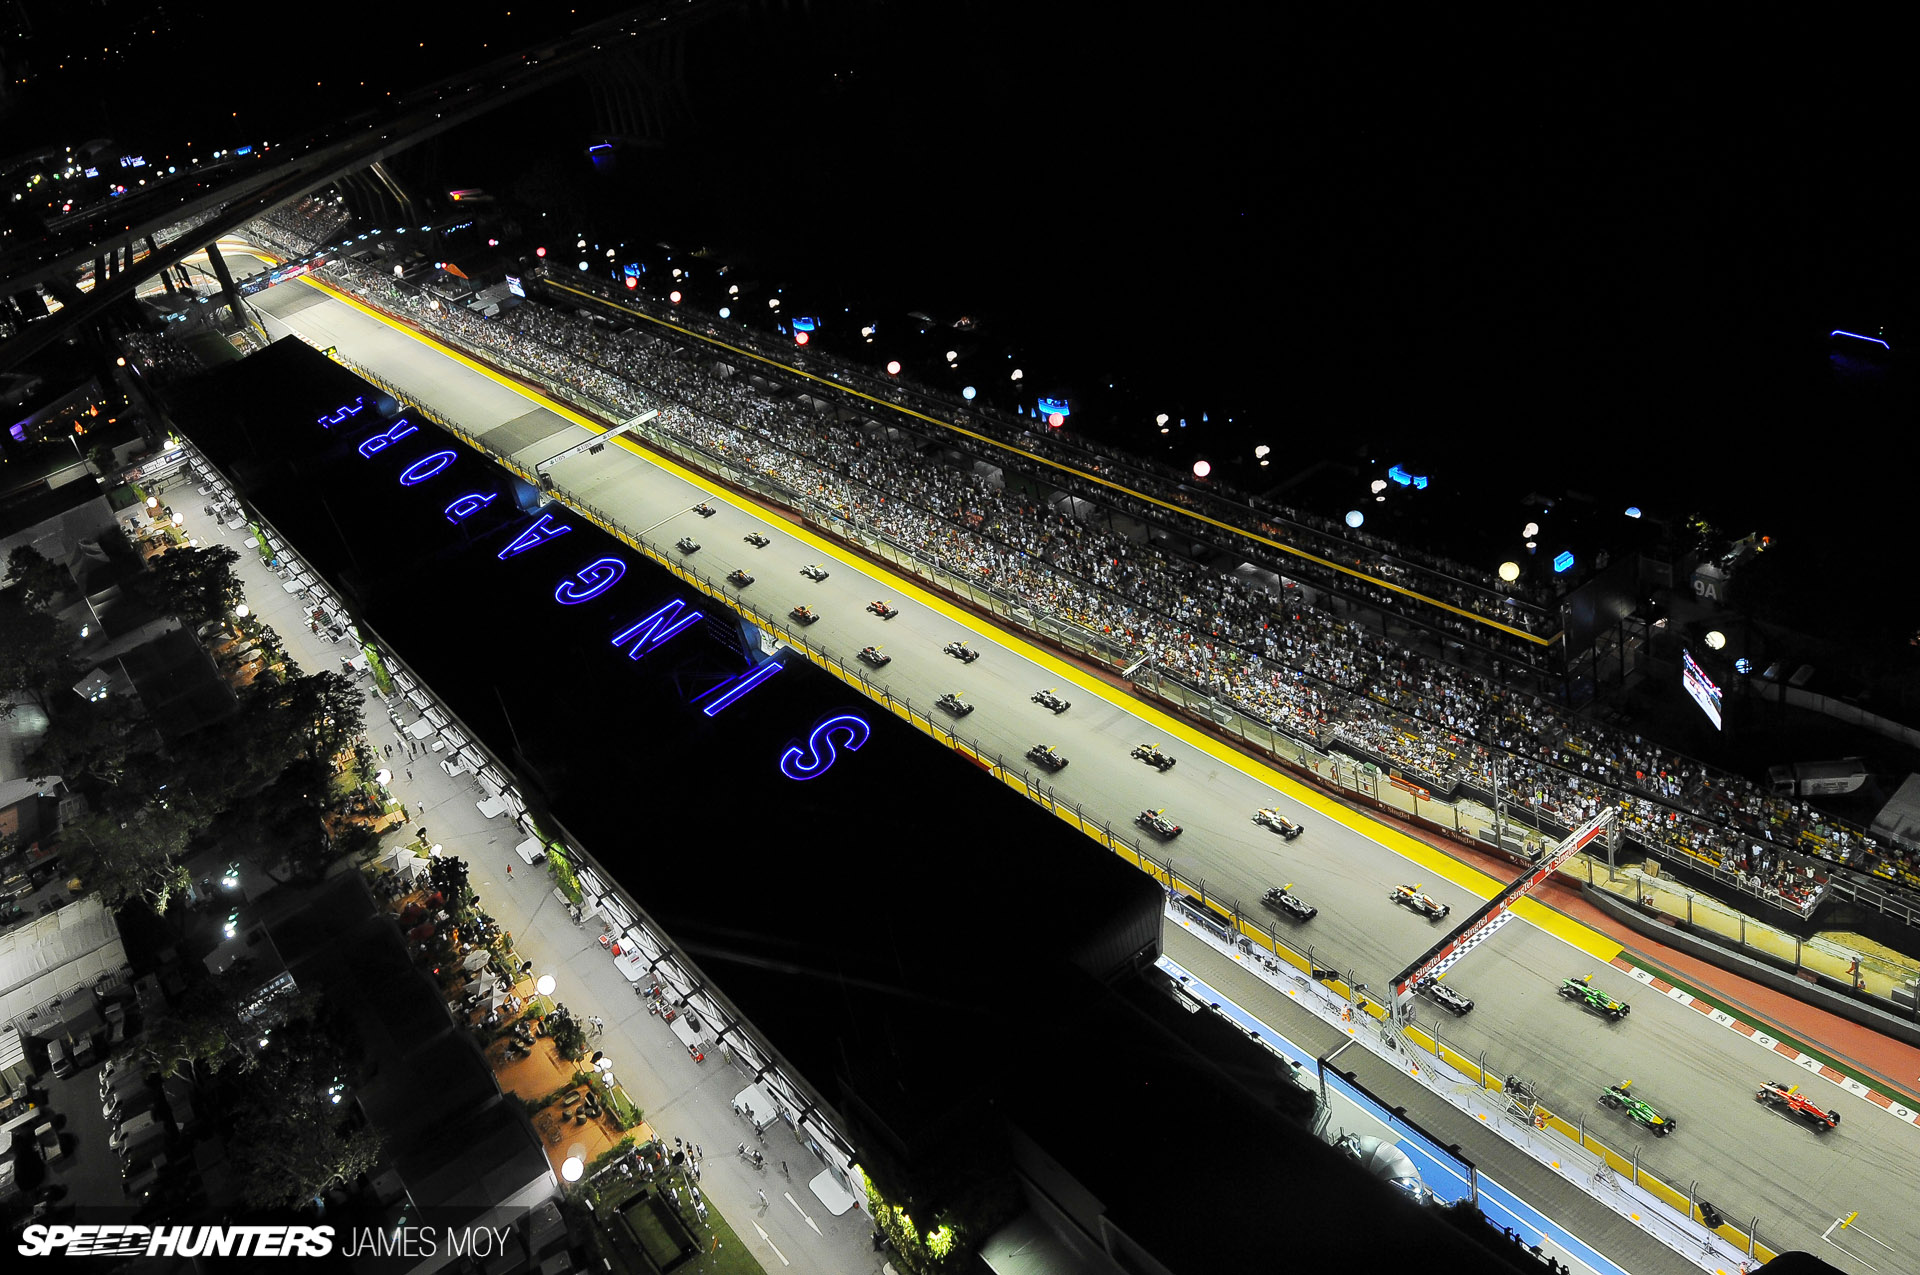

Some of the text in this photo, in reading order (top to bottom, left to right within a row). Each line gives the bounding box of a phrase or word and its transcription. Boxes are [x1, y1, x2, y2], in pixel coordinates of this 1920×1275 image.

[1694, 580, 1717, 600] 9A
[1554, 842, 1578, 867] SingTel
[1509, 879, 1534, 903] SingTel
[1463, 915, 1488, 940] SingTel
[1415, 953, 1441, 980] SingTel
